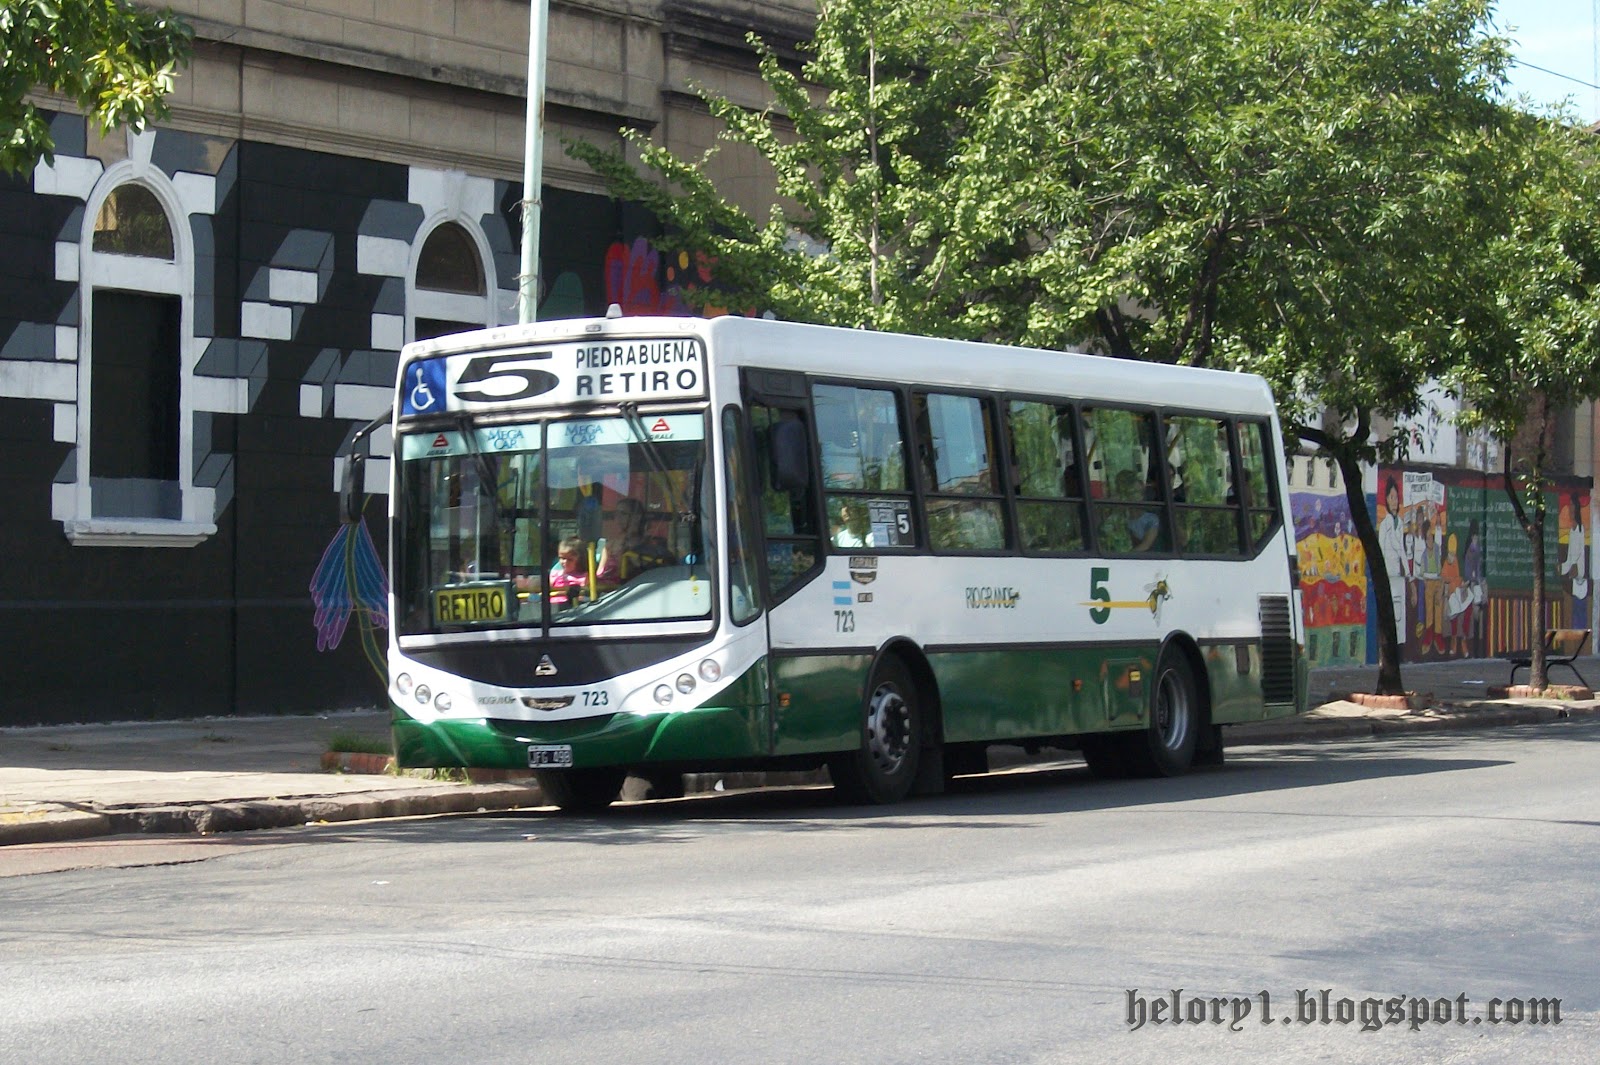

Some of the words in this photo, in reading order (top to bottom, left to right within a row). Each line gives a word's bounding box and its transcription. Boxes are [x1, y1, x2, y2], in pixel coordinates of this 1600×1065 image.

[576, 340, 698, 369] PIEDRABUENA
[453, 351, 560, 401] 5
[576, 368, 697, 396] RETIRO
[488, 429, 524, 441] MEGA
[565, 424, 604, 437] MEGA
[897, 513, 910, 534] 5
[439, 590, 504, 622] RETIRO
[1089, 567, 1111, 624] 5
[834, 610, 855, 632] 723
[582, 691, 609, 706] 723
